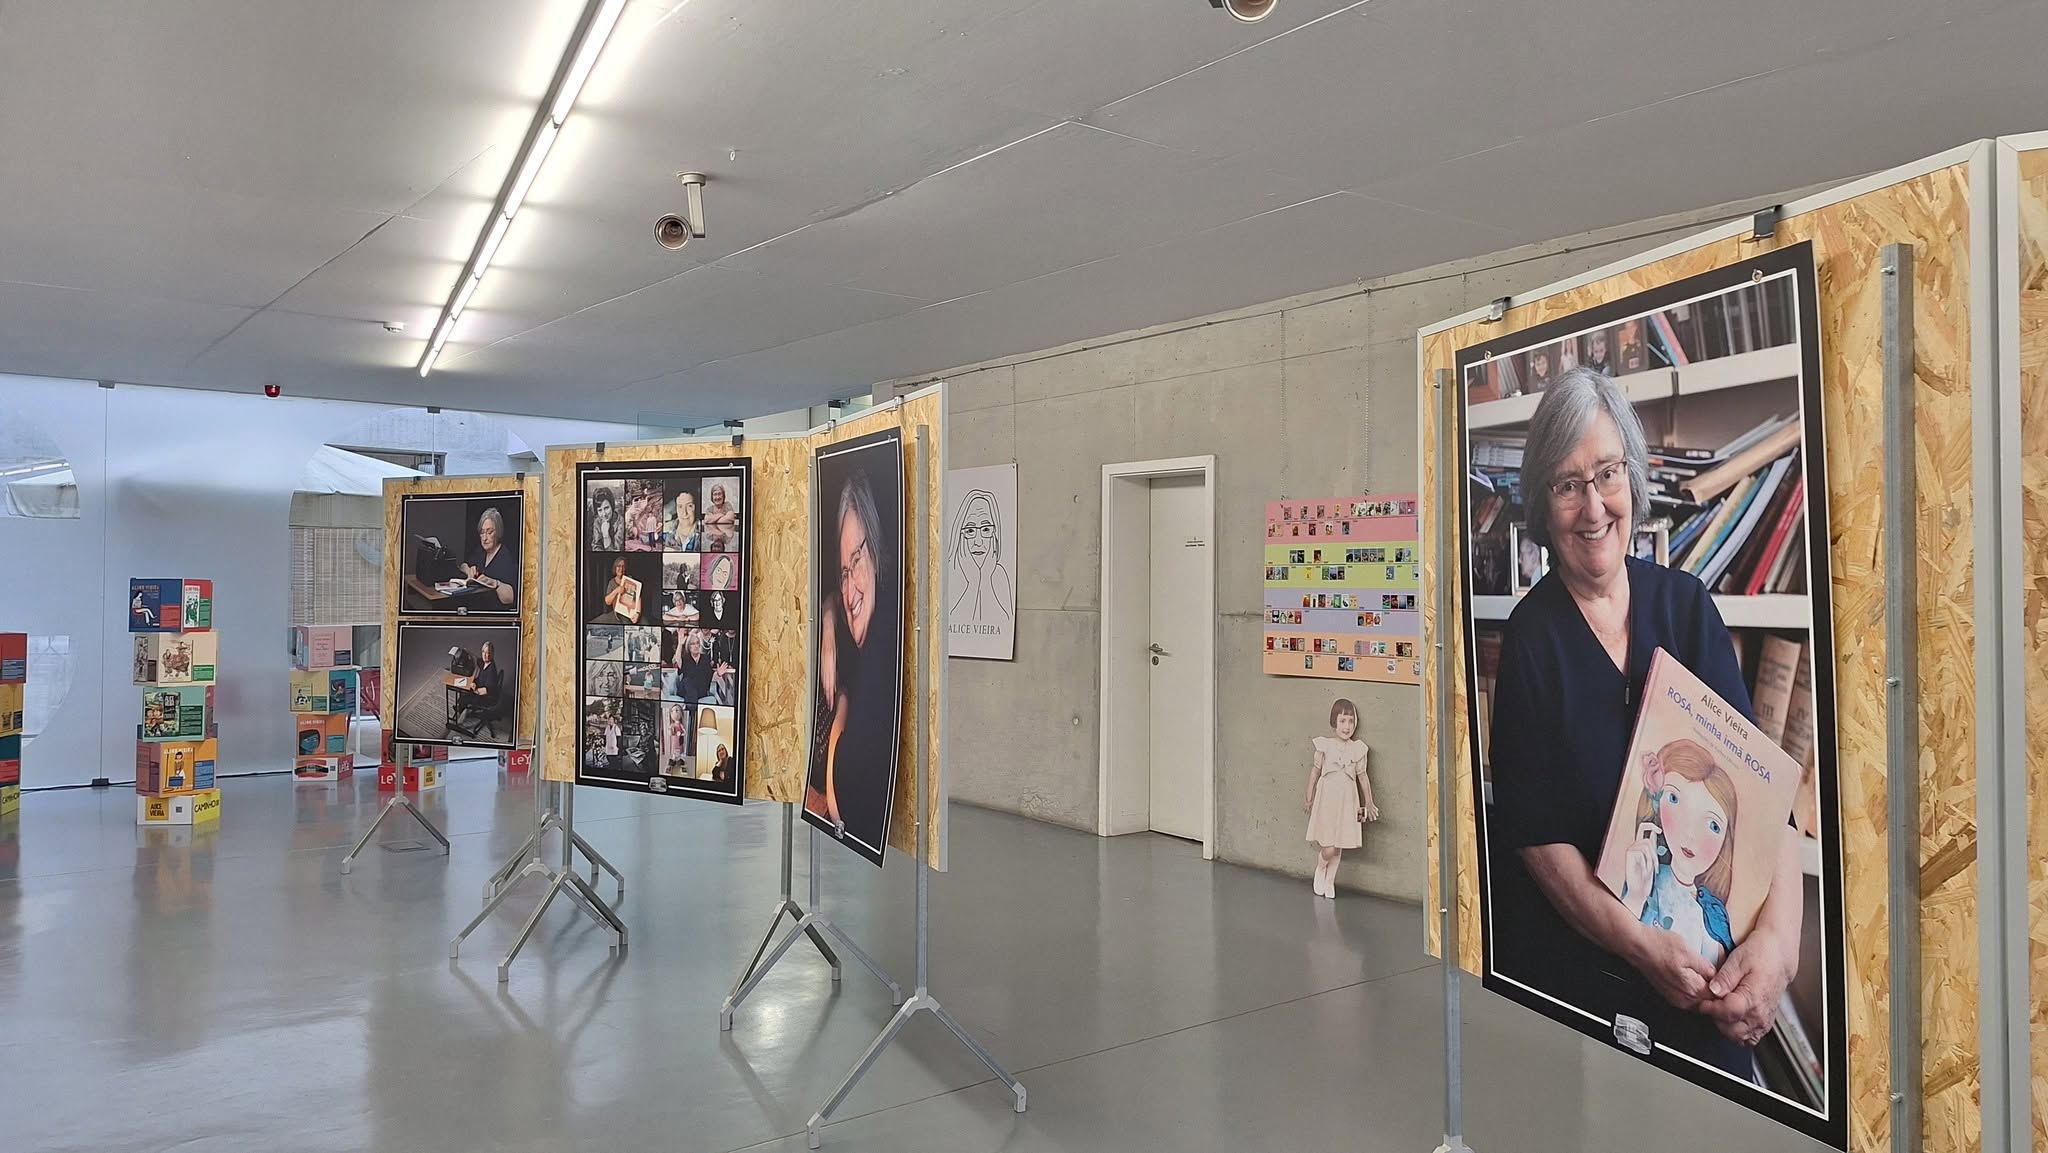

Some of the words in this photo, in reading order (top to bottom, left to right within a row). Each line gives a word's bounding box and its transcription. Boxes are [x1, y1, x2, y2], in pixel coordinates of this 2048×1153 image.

[948, 623, 971, 634] ALICE
[973, 624, 1001, 635] VIEIRA
[1667, 686, 1694, 717] ROSA,
[1695, 713, 1722, 741] minha
[1723, 734, 1744, 759] irmã
[1744, 753, 1772, 784] ROSA
[1701, 694, 1722, 717] Alice
[1724, 711, 1749, 740] Vieira
